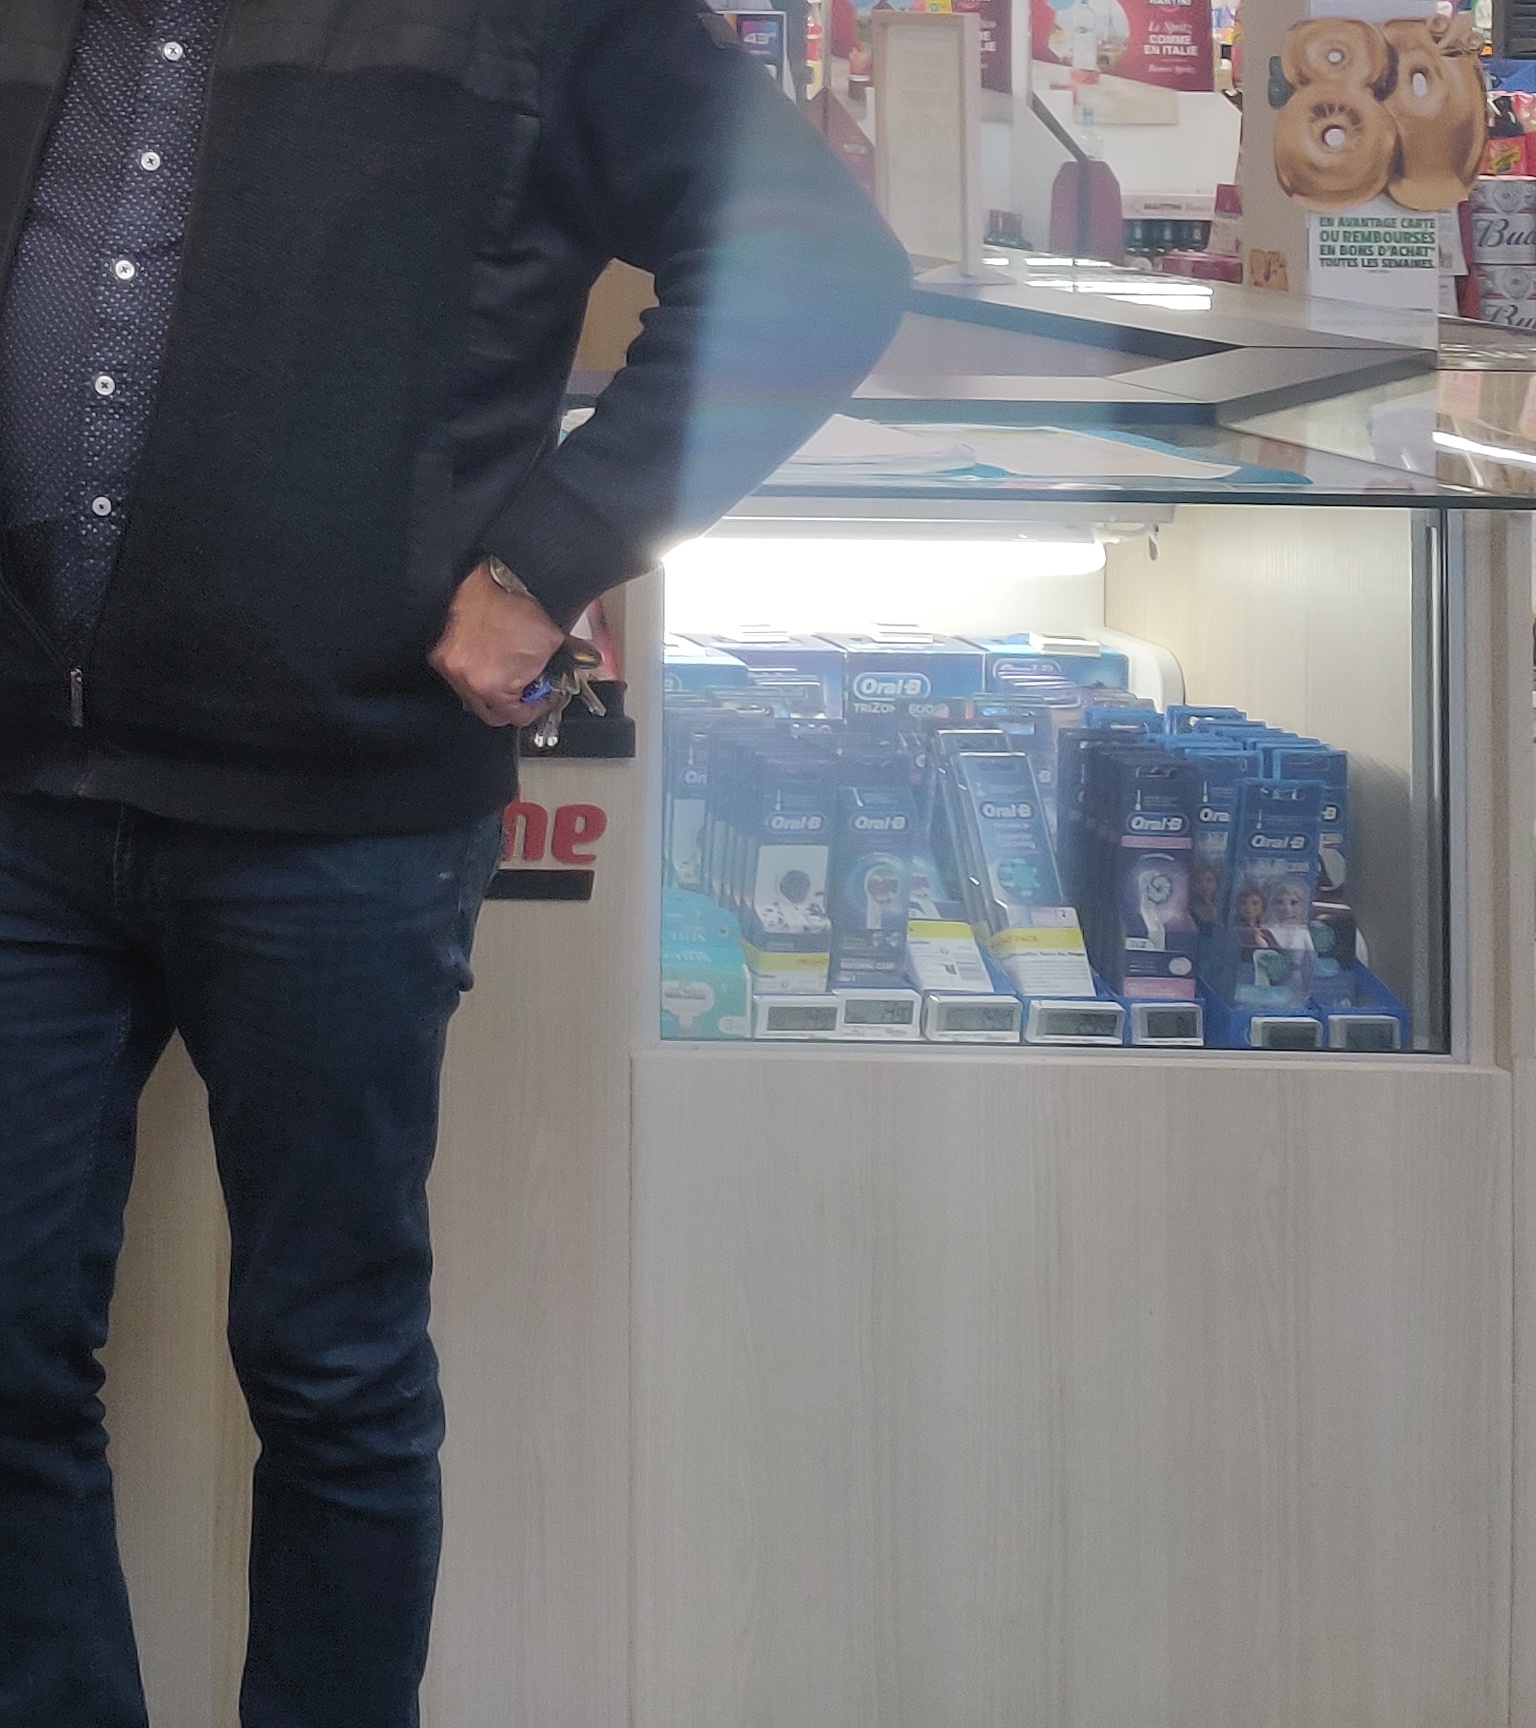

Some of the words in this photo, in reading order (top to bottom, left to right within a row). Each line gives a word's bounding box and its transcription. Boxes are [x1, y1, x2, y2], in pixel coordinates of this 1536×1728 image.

[1320, 231, 1339, 242] OU
[1320, 245, 1335, 255] EN
[1339, 245, 1374, 256] BONS
